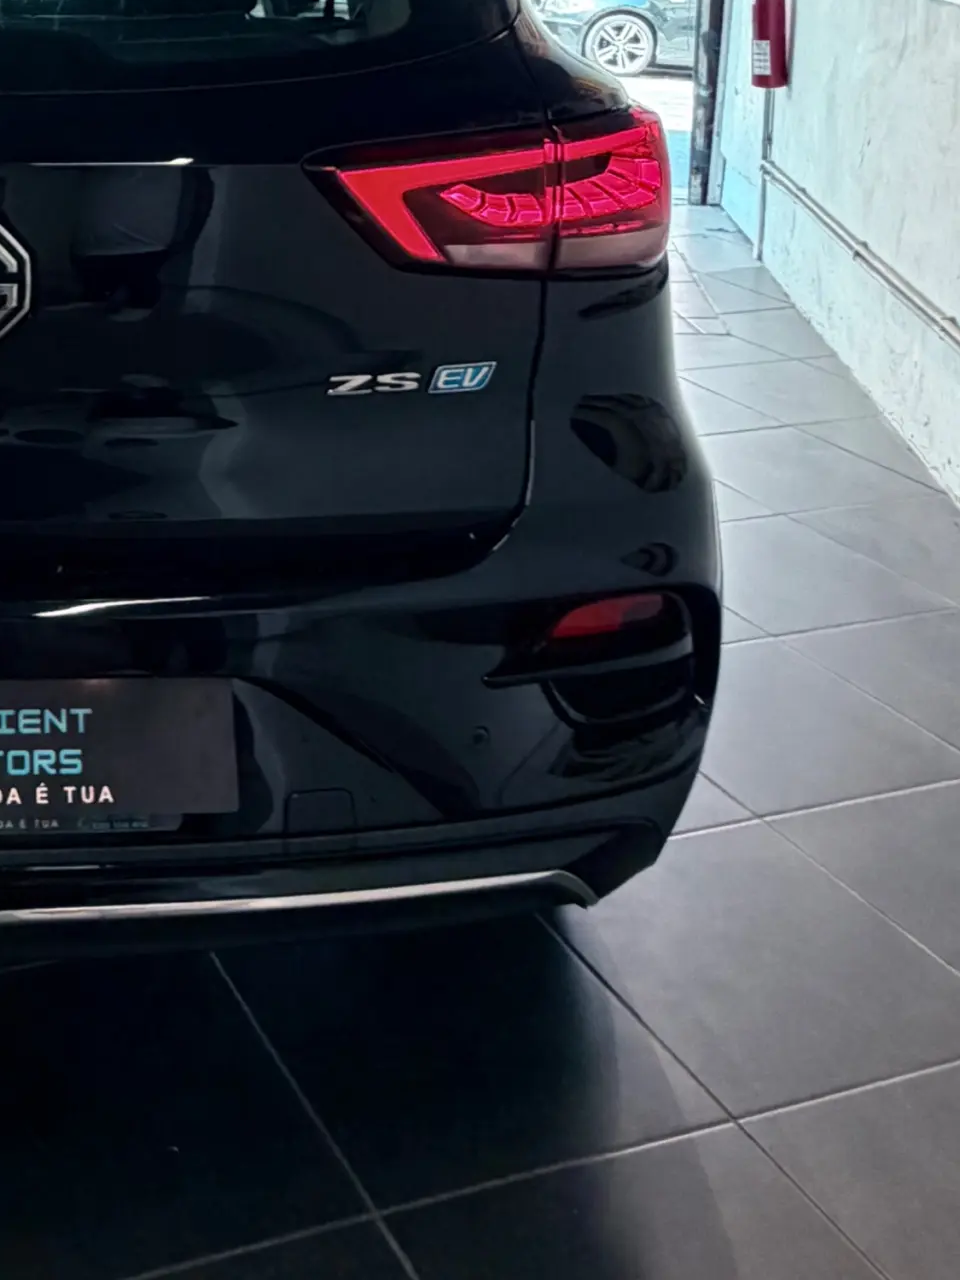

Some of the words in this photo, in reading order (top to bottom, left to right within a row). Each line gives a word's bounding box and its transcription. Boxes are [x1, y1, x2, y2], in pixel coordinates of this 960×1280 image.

[327, 372, 421, 395] ZS
[435, 365, 491, 389] EV
[36, 782, 49, 804] É
[63, 785, 114, 804] TUA
